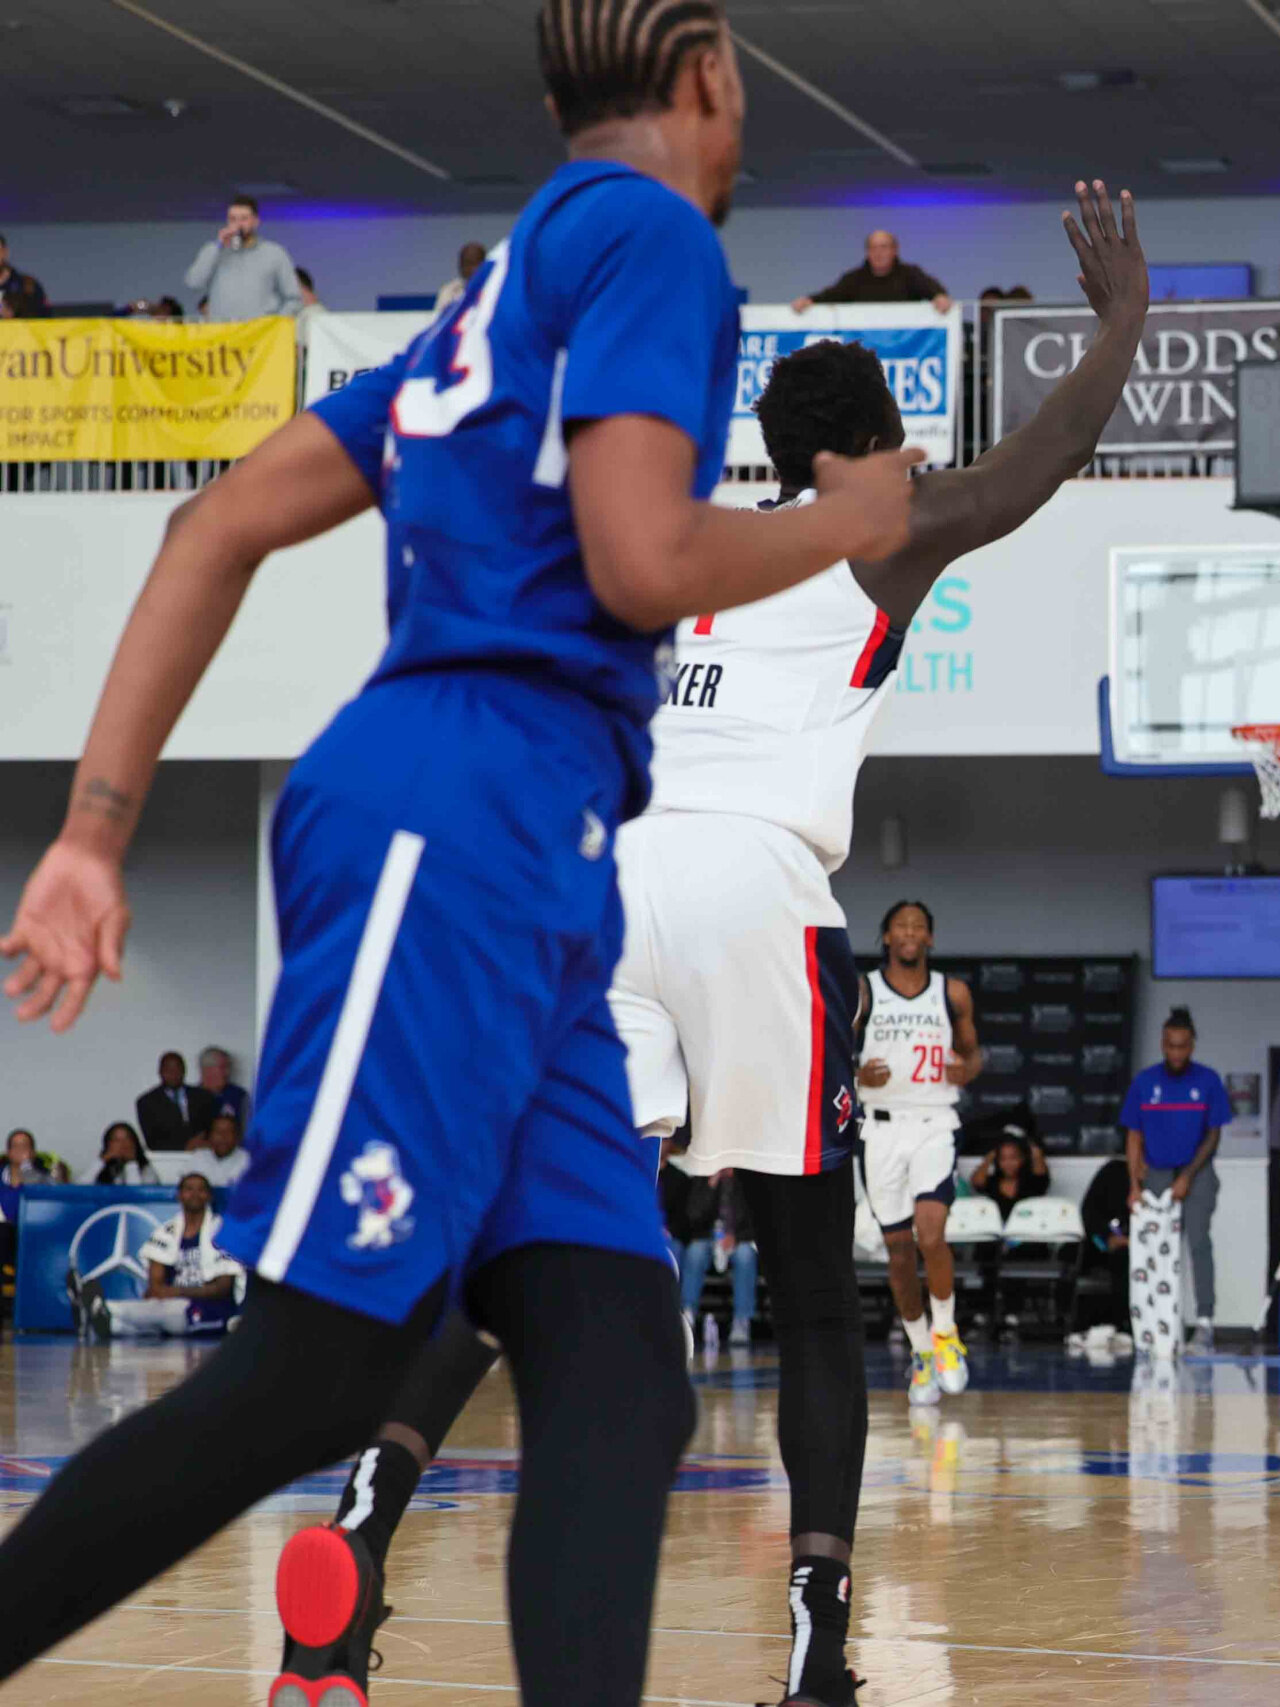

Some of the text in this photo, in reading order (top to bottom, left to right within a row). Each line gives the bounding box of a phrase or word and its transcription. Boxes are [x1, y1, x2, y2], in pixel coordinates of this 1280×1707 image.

[1123, 379, 1237, 426] WIN
[665, 662, 724, 708] KER
[871, 1014, 944, 1027] CAPITAL
[874, 1029, 914, 1041] CITY
[911, 1045, 945, 1083] 29
